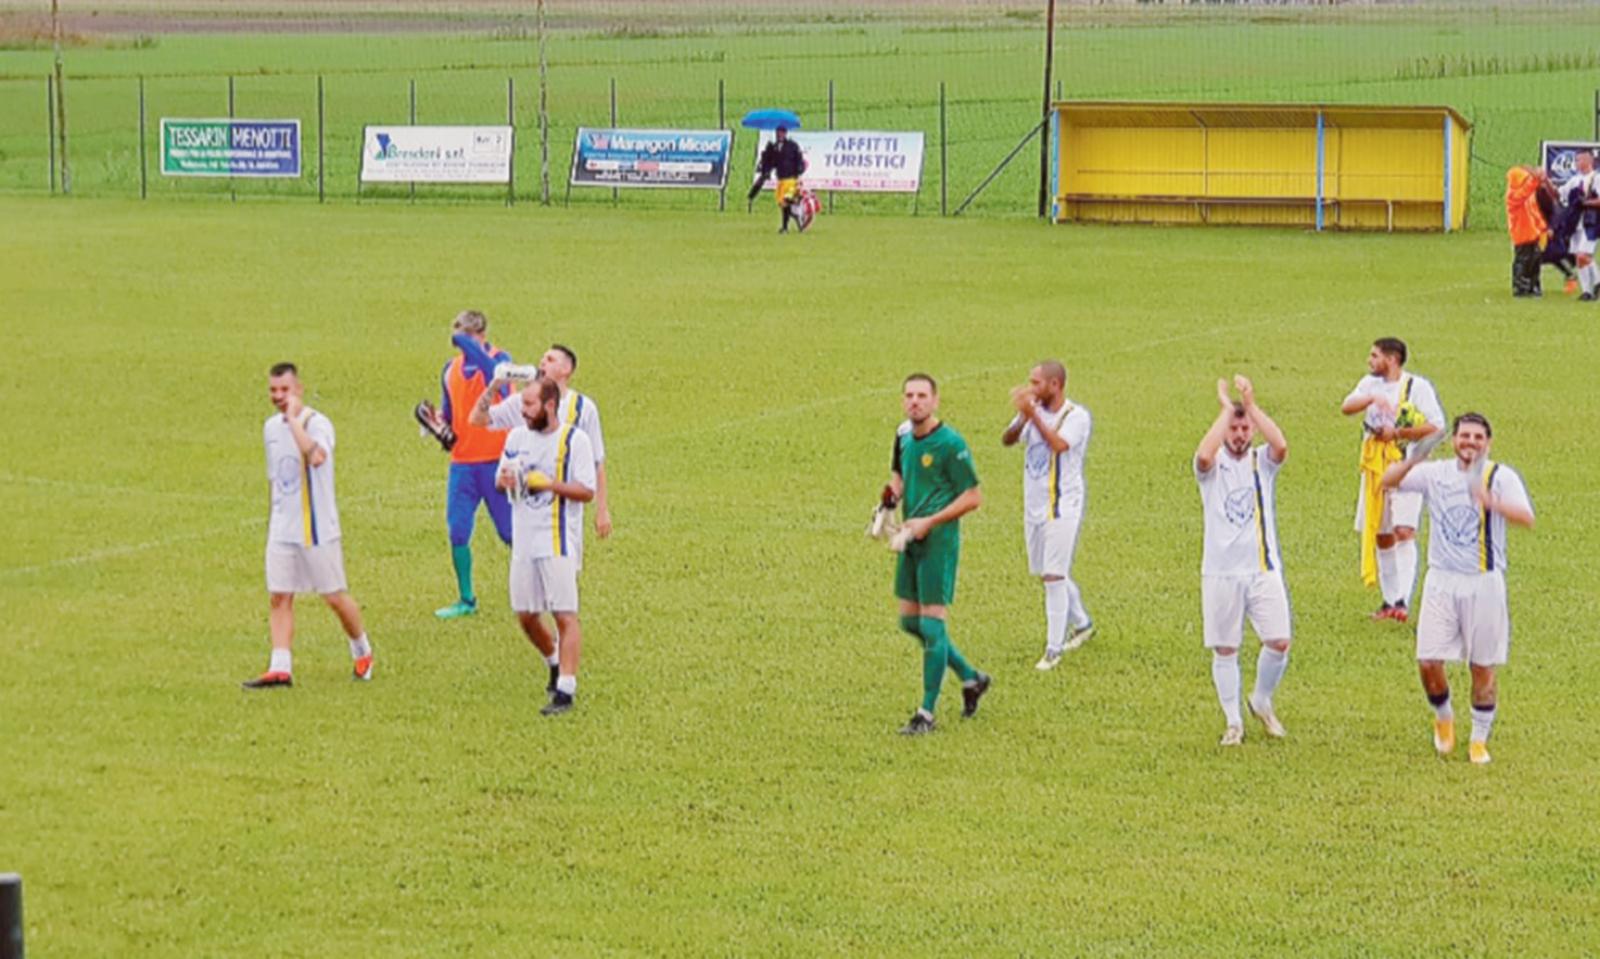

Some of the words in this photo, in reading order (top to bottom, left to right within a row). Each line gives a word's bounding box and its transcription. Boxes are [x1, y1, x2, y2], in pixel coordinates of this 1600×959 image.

[169, 126, 228, 148] TESSARIN
[231, 127, 291, 148] MENOTTI
[833, 136, 899, 152] AFFITTI
[824, 153, 906, 169] TURISTICI
